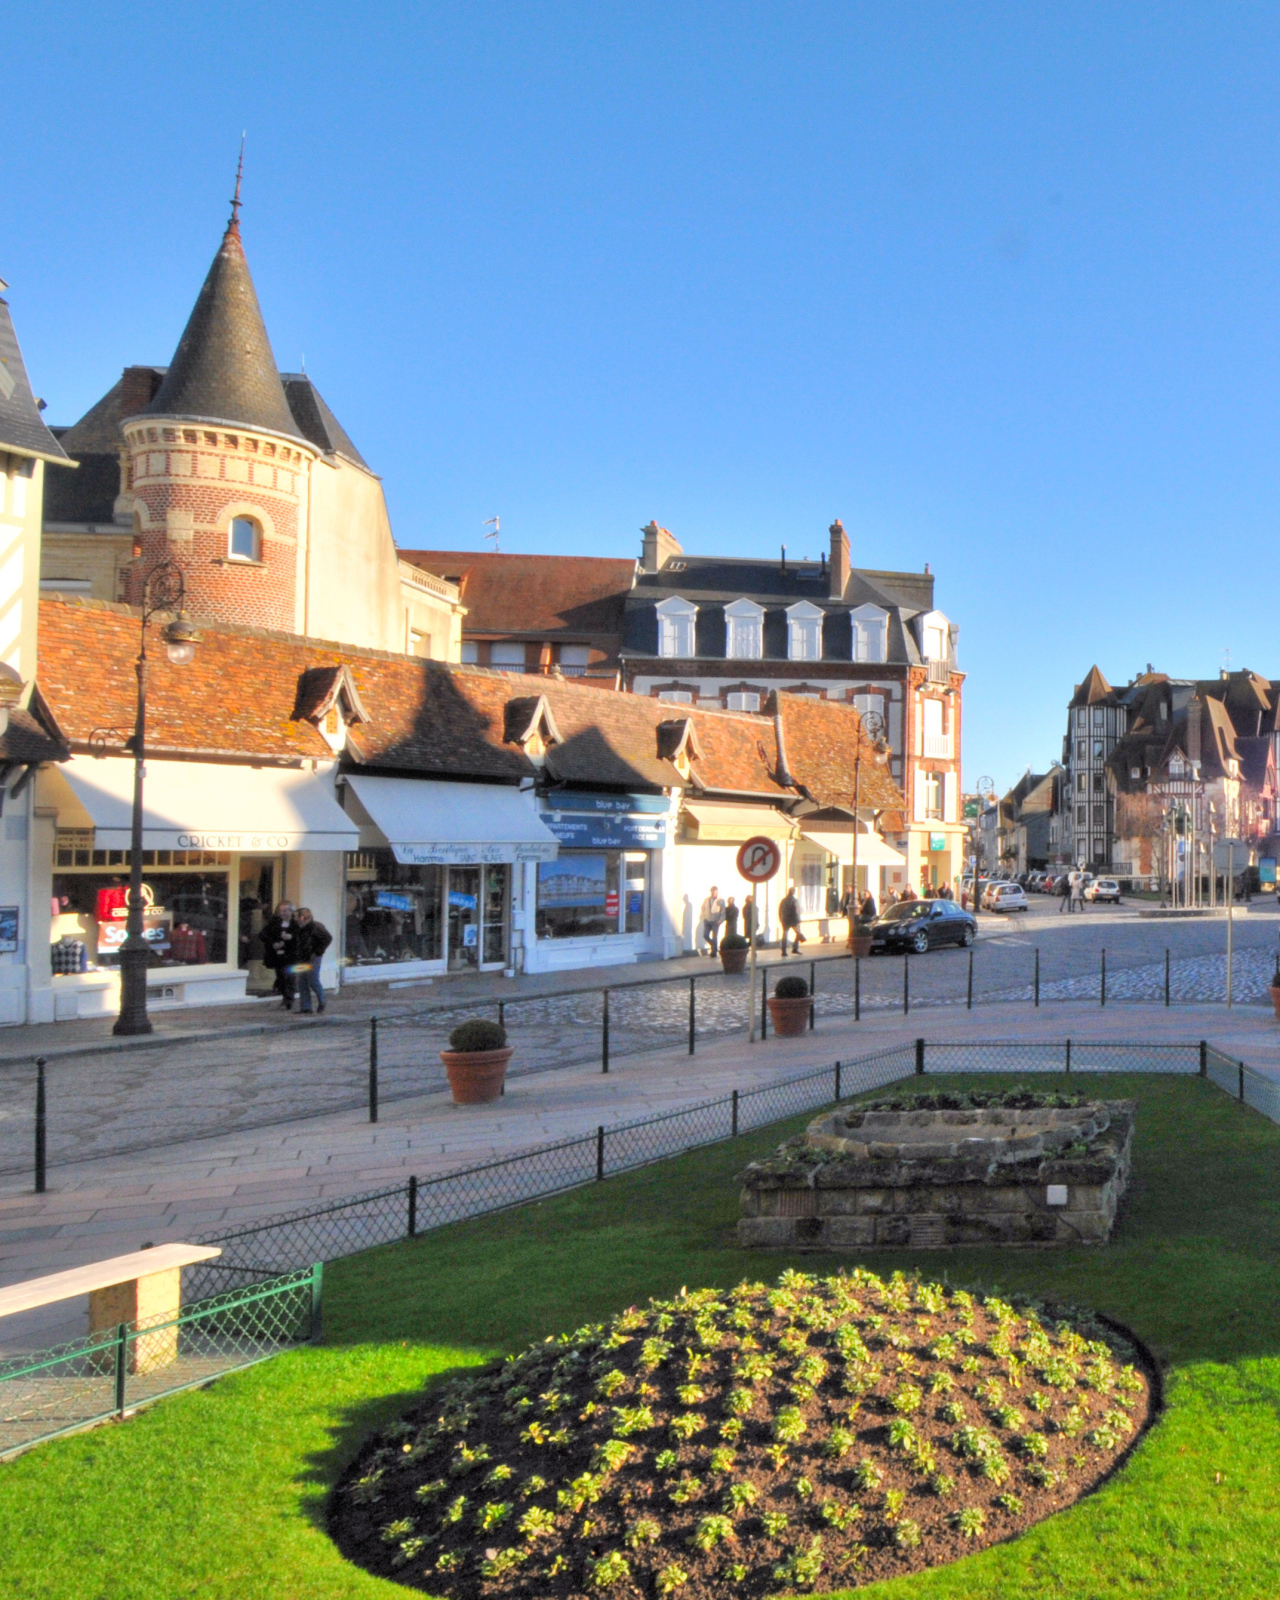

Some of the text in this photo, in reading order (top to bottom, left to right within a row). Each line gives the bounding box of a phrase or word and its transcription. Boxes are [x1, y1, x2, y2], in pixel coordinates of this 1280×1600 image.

[596, 800, 630, 810] blue bay
[177, 834, 243, 848] CRICKET
[251, 836, 261, 848] &
[592, 837, 621, 846] blue bay
[413, 855, 445, 863] Homme
[104, 925, 165, 943] Soes
